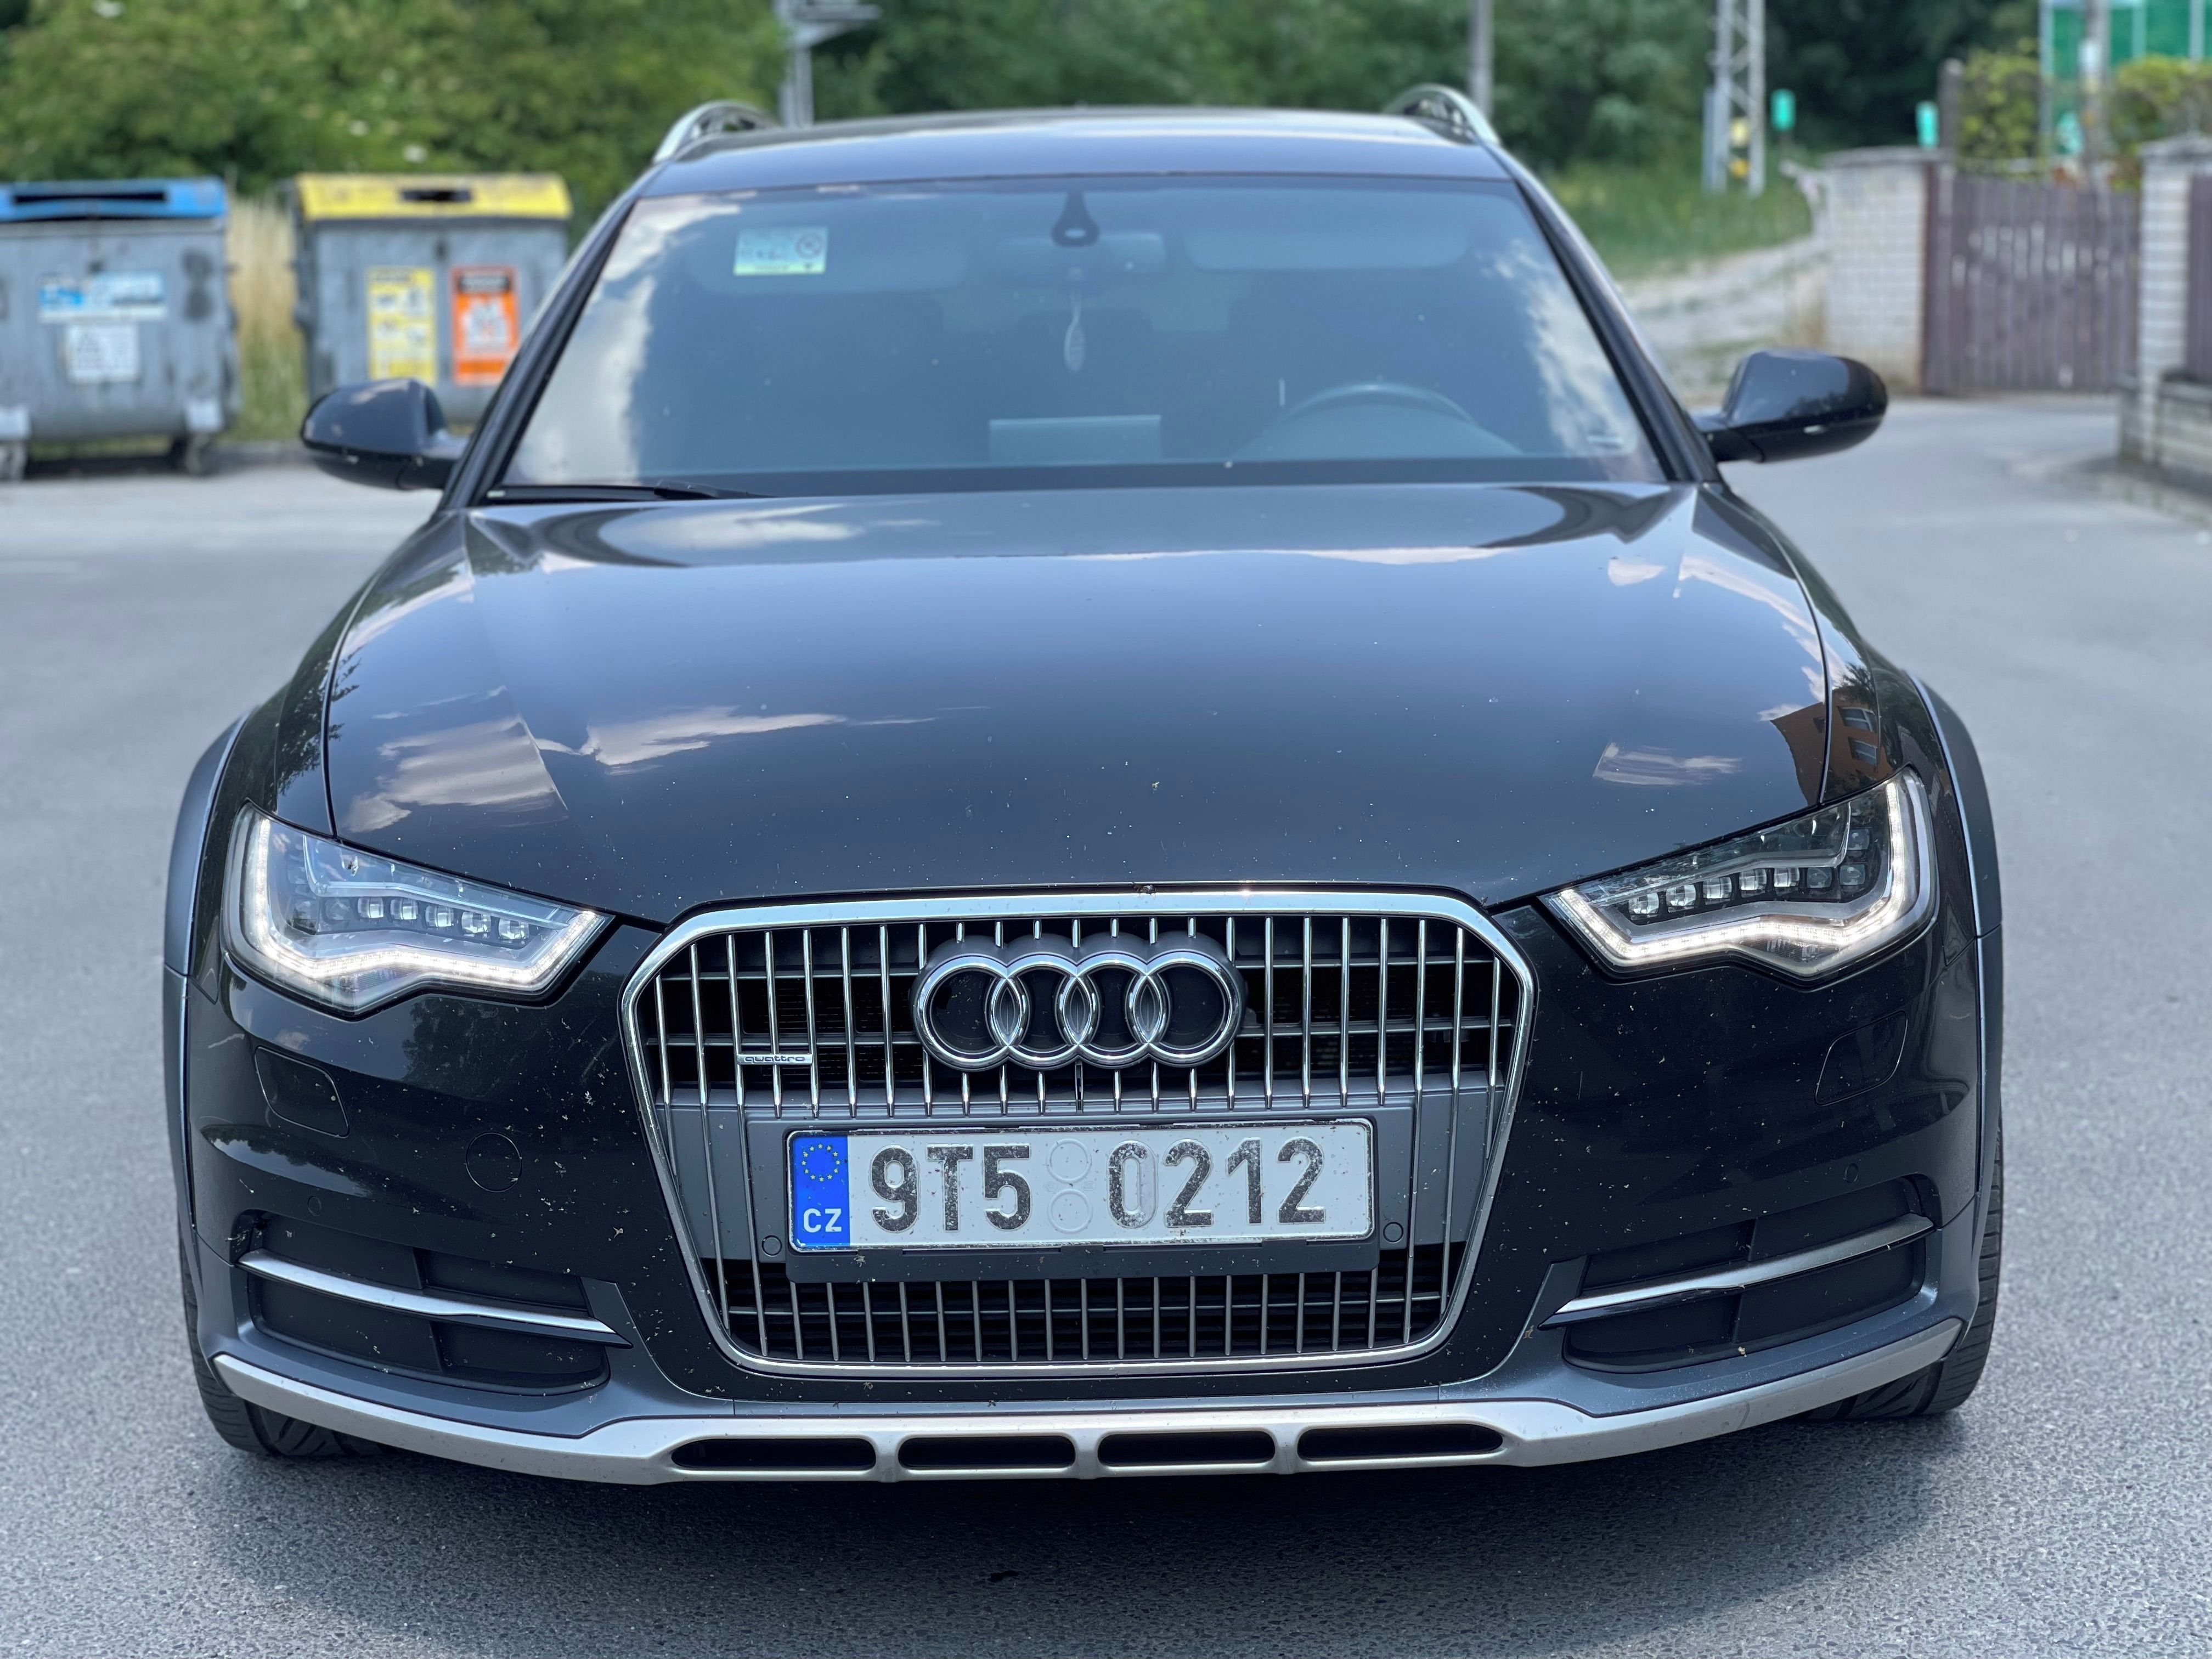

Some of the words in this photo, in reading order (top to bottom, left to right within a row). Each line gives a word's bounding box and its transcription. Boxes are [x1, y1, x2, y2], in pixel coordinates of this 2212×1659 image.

[745, 1056, 805, 1064] quattro
[871, 1143, 1032, 1233] 9T5
[1108, 1137, 1326, 1228] 0212
[803, 1208, 842, 1233] CZ
